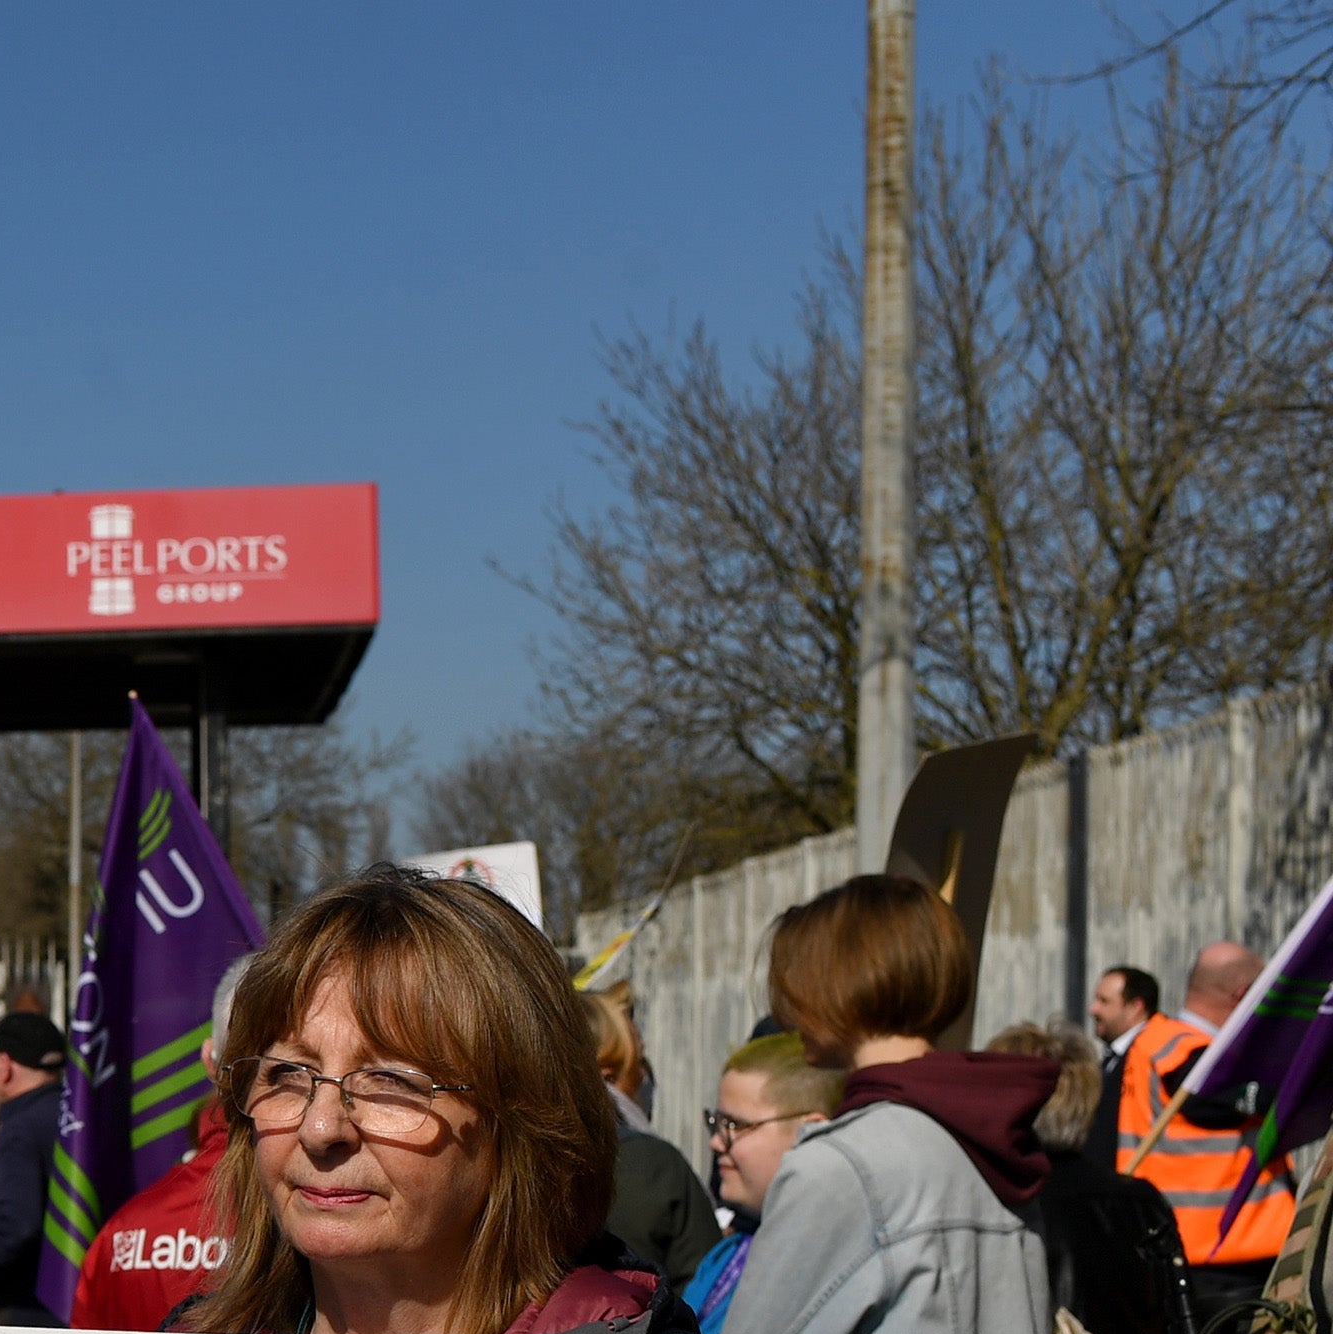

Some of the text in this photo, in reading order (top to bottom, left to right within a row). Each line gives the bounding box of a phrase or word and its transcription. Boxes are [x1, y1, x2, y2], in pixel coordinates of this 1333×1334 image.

[65, 533, 289, 578] PEEL PORTS
[155, 583, 244, 606] GROUP
[135, 1227, 235, 1271] Labo
